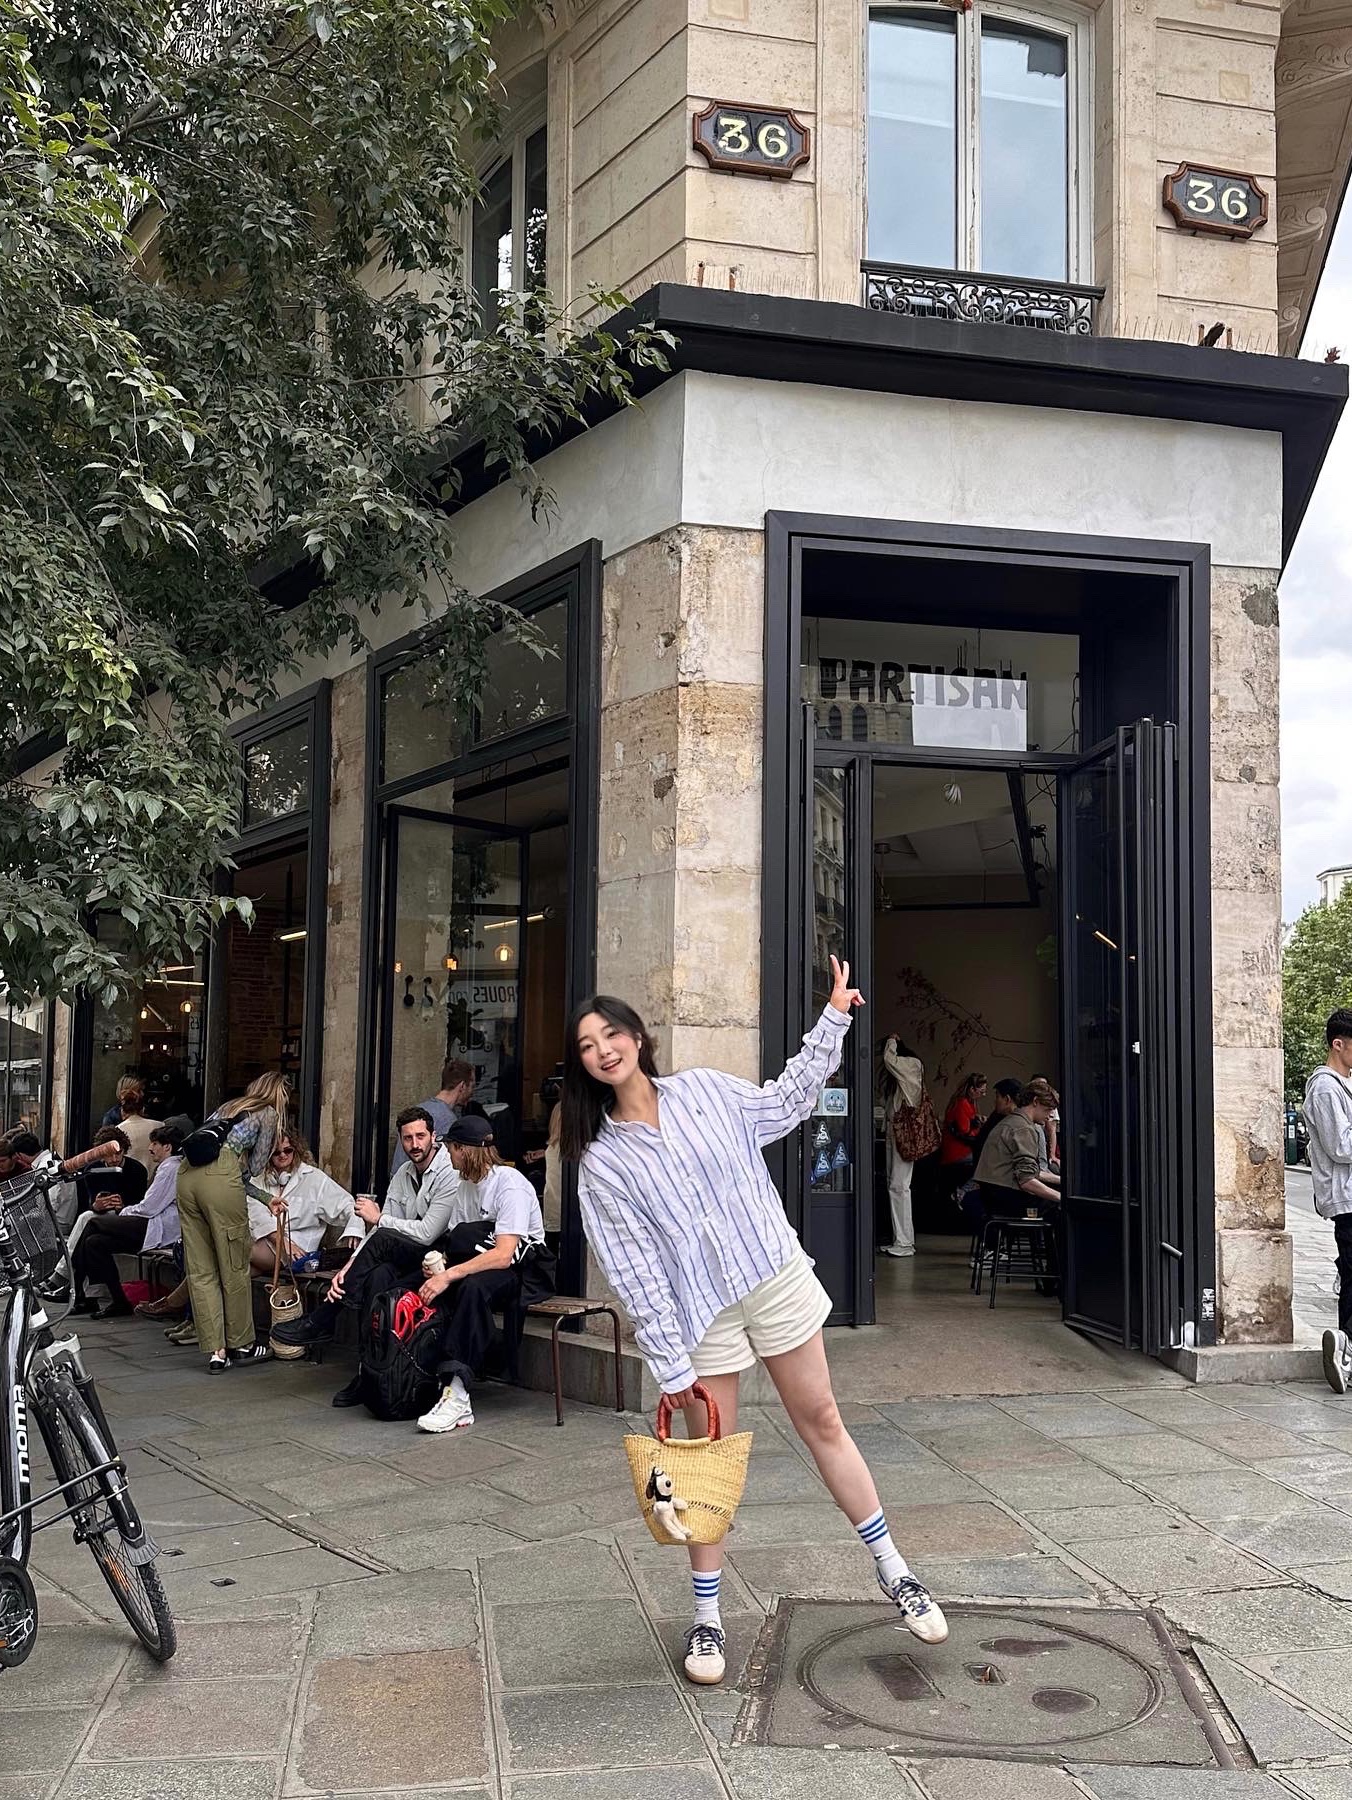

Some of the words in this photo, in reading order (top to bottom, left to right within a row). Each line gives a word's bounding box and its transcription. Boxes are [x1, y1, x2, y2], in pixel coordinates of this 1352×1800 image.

[718, 117, 788, 158] 36
[1187, 179, 1248, 219] 36
[819, 657, 1027, 710] PARTISAN
[13, 1384, 30, 1484] moma
